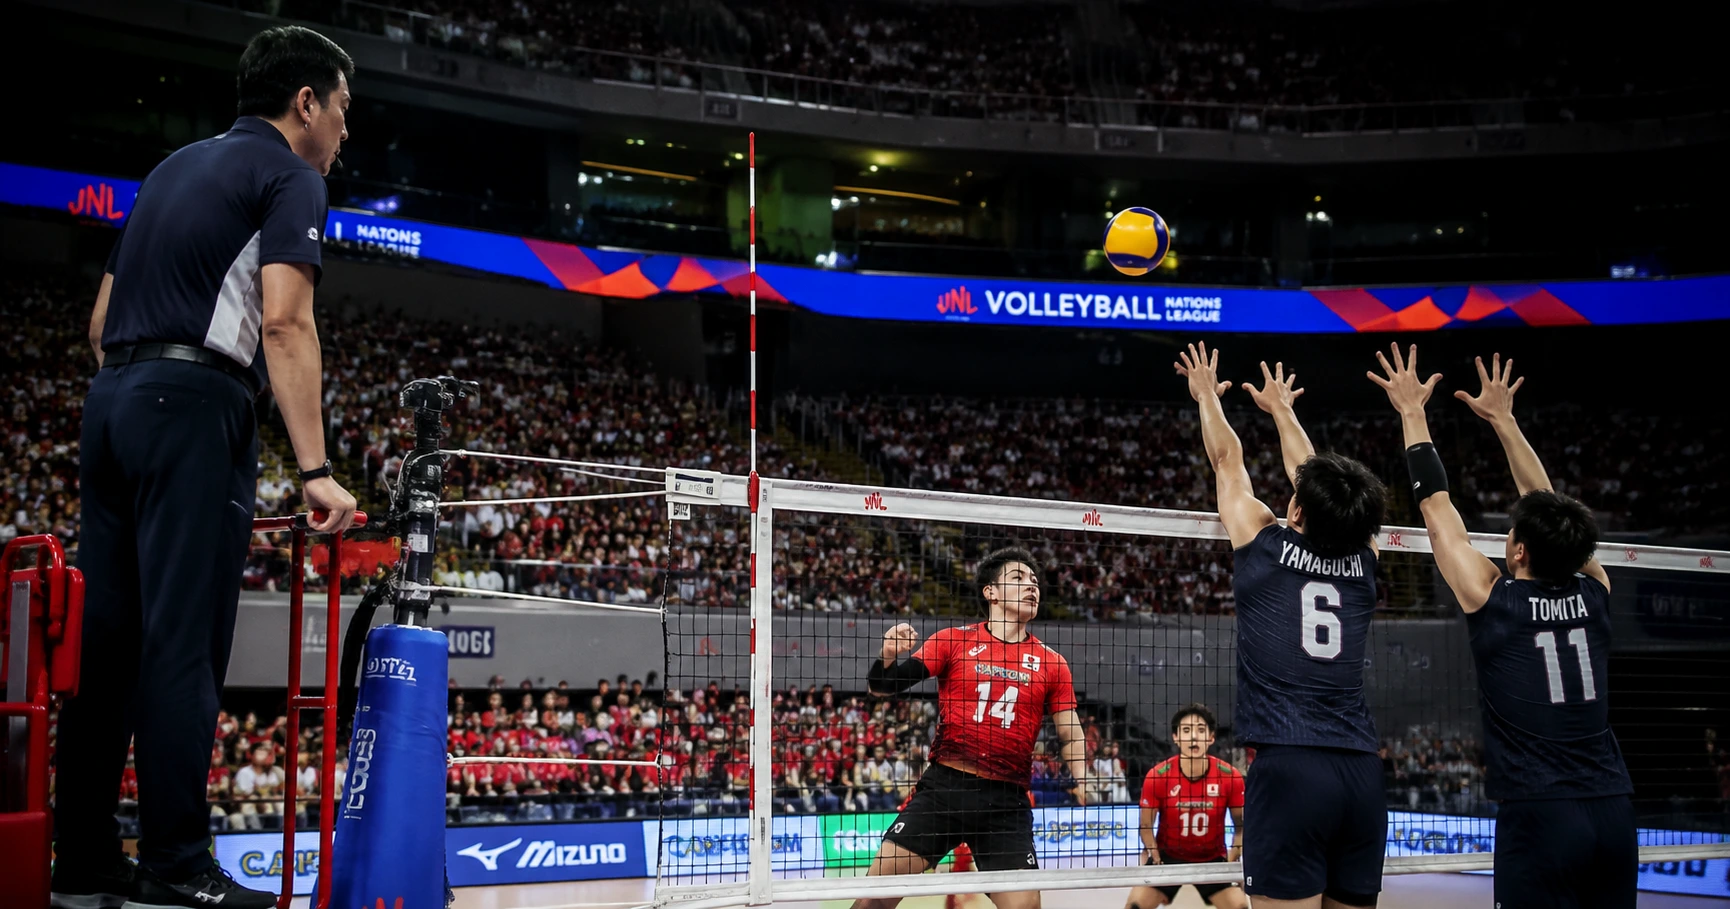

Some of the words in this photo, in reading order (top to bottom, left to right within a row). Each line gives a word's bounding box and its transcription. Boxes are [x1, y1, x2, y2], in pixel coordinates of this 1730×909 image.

[985, 289, 1162, 321] VOLLEYBALL
[1164, 296, 1222, 310] NATIONS
[1165, 309, 1221, 323] LEAGUE
[1279, 540, 1364, 578] YAMAGUCHI
[1300, 581, 1342, 660] 6
[1528, 594, 1589, 622] TOMITA
[1534, 627, 1597, 704] 11
[972, 681, 1020, 729] 14
[1179, 811, 1210, 838] 10
